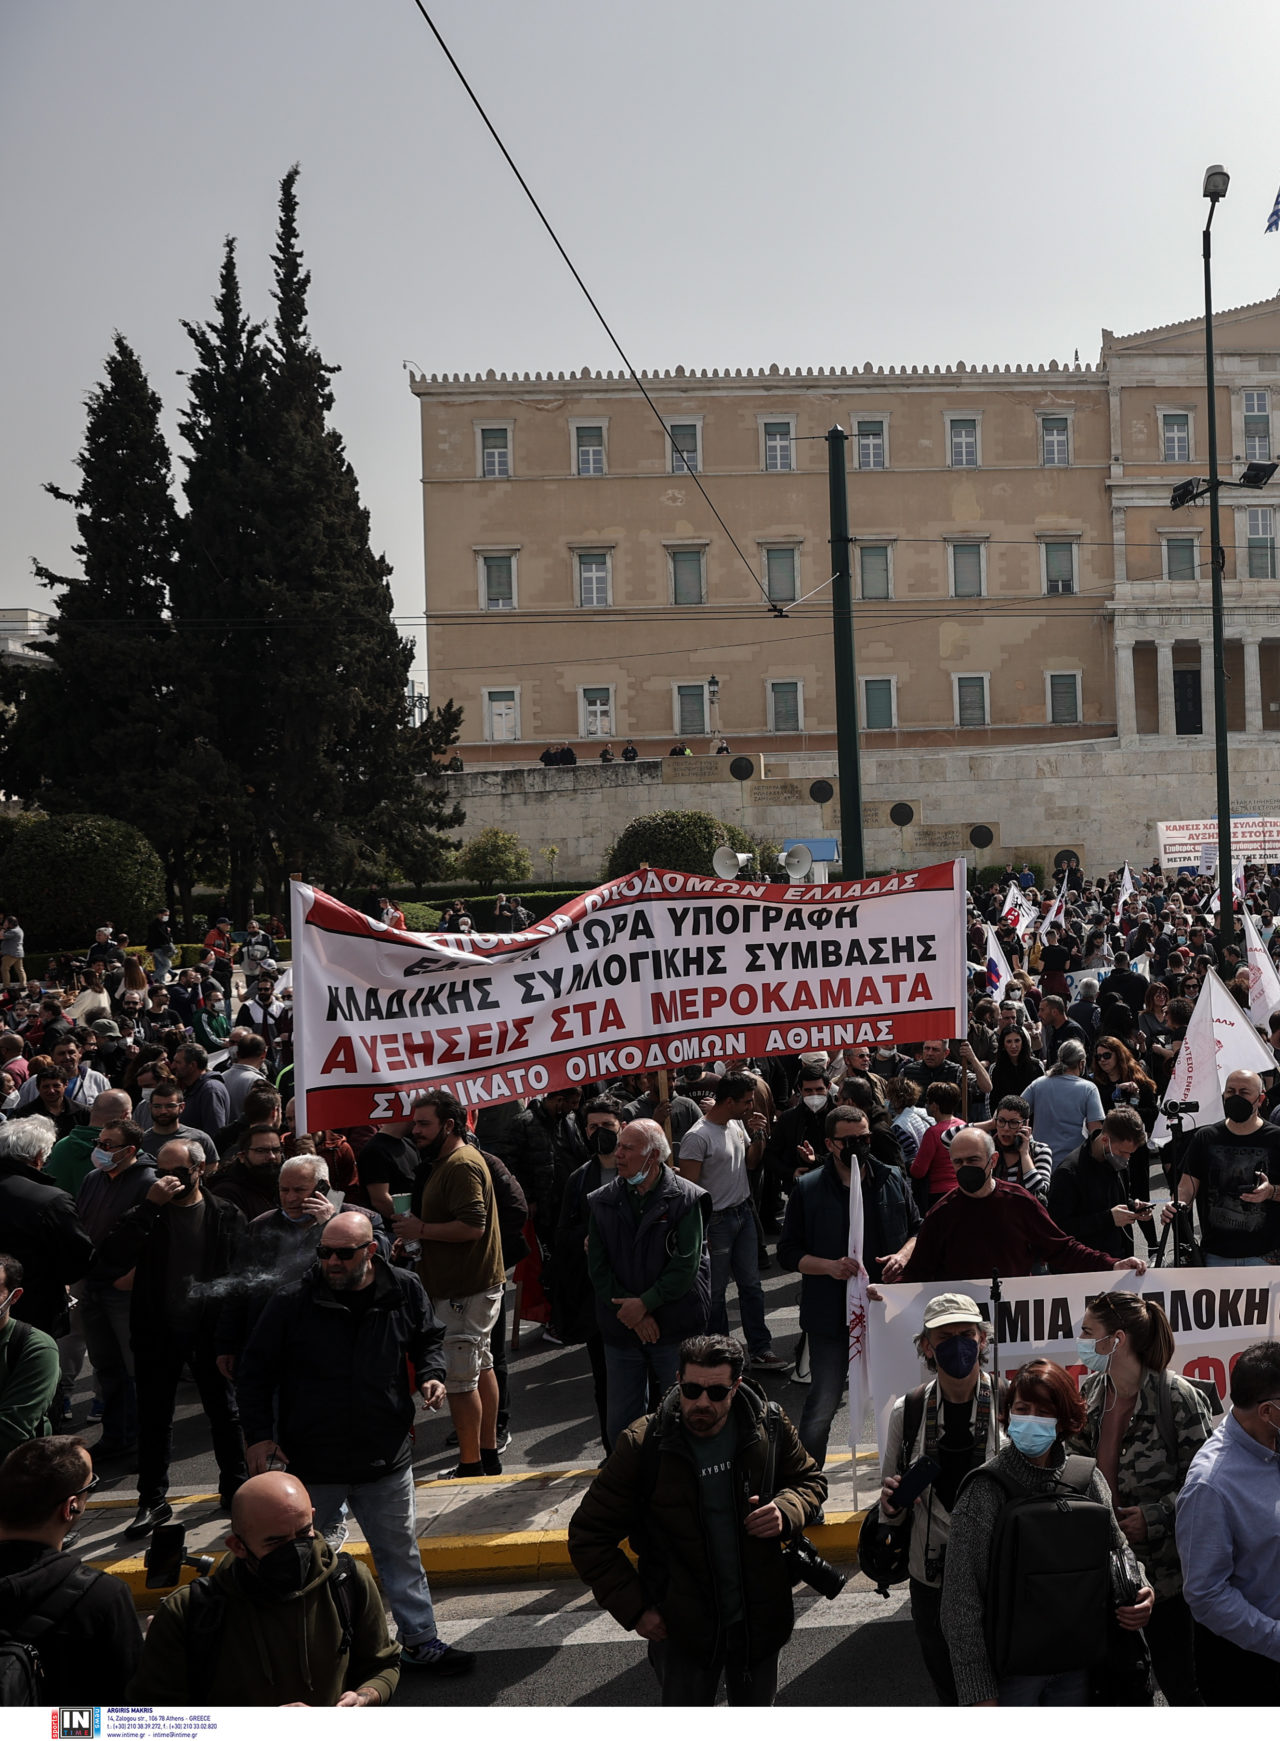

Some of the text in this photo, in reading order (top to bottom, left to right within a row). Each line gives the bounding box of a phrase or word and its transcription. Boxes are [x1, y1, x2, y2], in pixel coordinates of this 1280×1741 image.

[1165, 823, 1201, 832] ΚΑΝΕΙΣ
[783, 872, 919, 901] ΕΛΛΑΔΑΣ
[565, 904, 860, 954] ΤΩΡΑ ΥΠΟΓΡΑΦΗ
[745, 934, 937, 973] ΣΥΜΒΑΣΗΣ
[320, 972, 934, 1075] ΑΥΞΗΣΕΙΣ ΣΤΑ ΜΕΡΟΚΑΜΑΤΑ
[369, 1020, 895, 1120] ΣΥΙΚΑΤΟ ΟΙΚΟΔΟΜΩΝ ΑΘΗΝΑΣ
